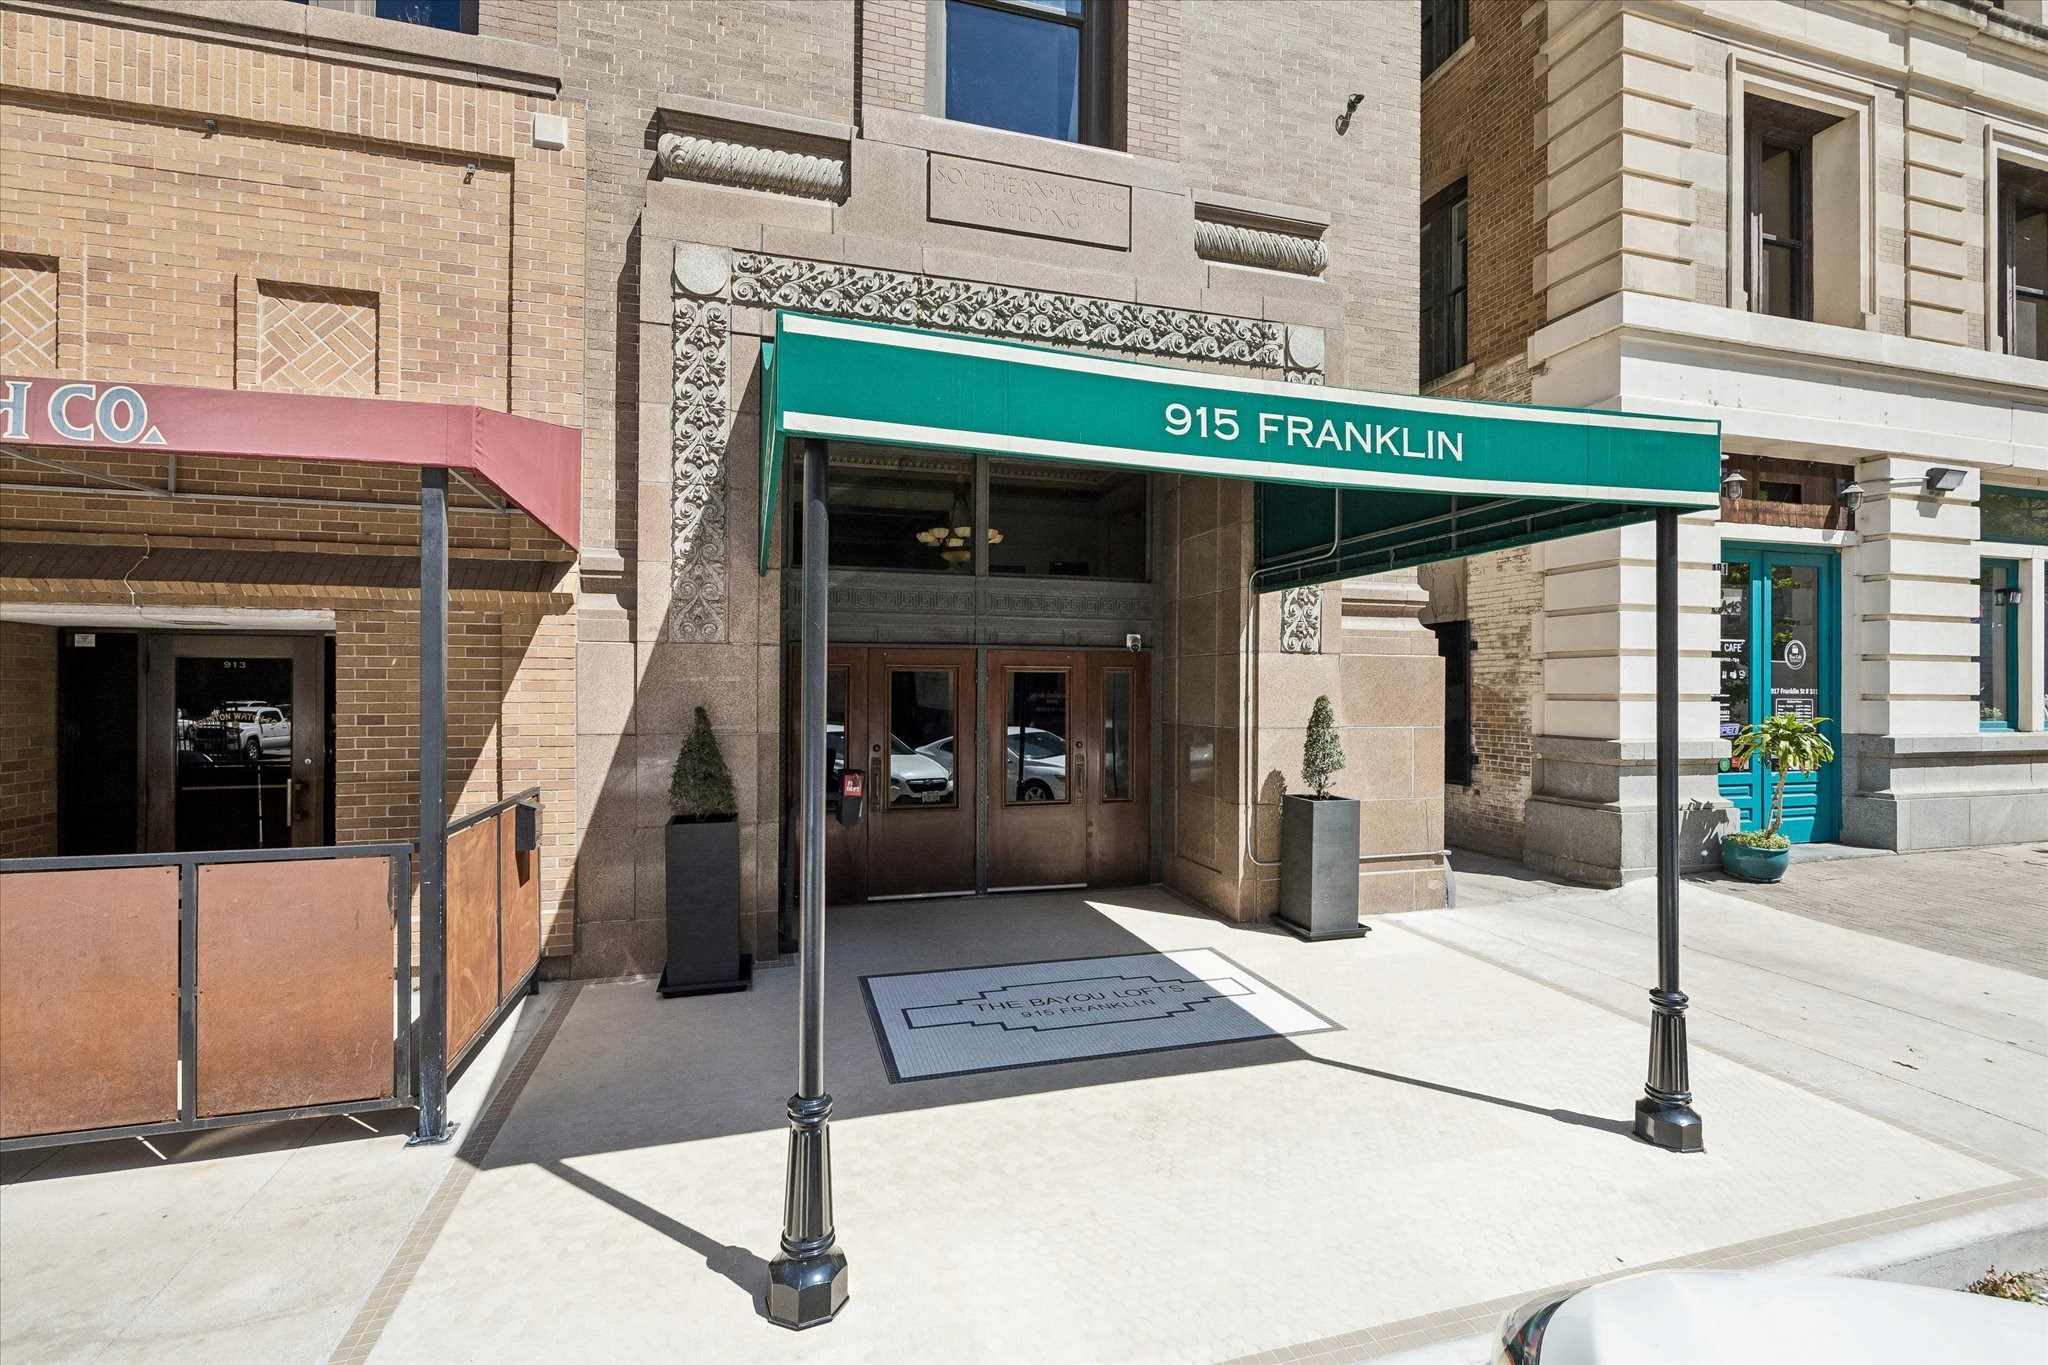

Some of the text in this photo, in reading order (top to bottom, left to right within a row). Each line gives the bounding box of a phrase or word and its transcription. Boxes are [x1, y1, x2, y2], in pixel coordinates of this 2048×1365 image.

[985, 199, 1080, 230] BUILDING
[1164, 402, 1463, 461] 915 FRANKLIN
[223, 661, 247, 669] 913
[971, 984, 1185, 1012] THE BAYOU LOFTS
[1021, 999, 1156, 1018] 915 FRANKLIN
